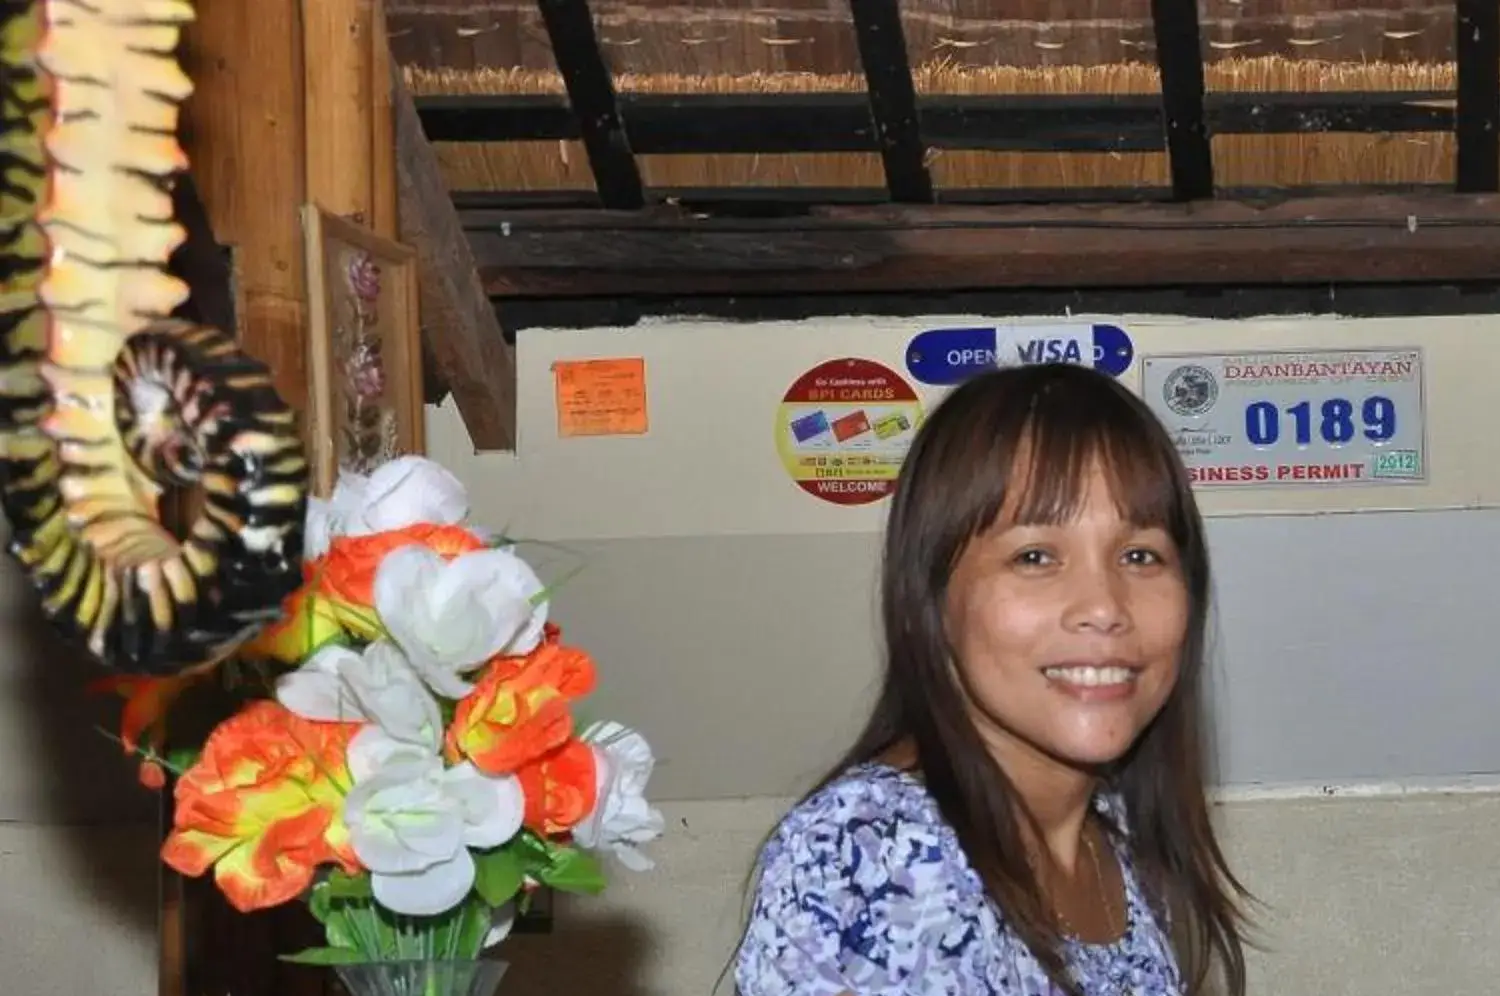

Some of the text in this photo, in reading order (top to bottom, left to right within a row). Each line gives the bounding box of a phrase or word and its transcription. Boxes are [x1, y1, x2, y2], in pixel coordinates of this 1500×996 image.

[1017, 339, 1083, 365] VISA
[1224, 361, 1412, 379] DAANBANTAYAN
[840, 388, 895, 399] CARDS
[1246, 396, 1396, 445] 0189
[1379, 455, 1413, 469] 2012
[1277, 463, 1365, 480] PERMIT
[817, 481, 887, 493] WELCOME
